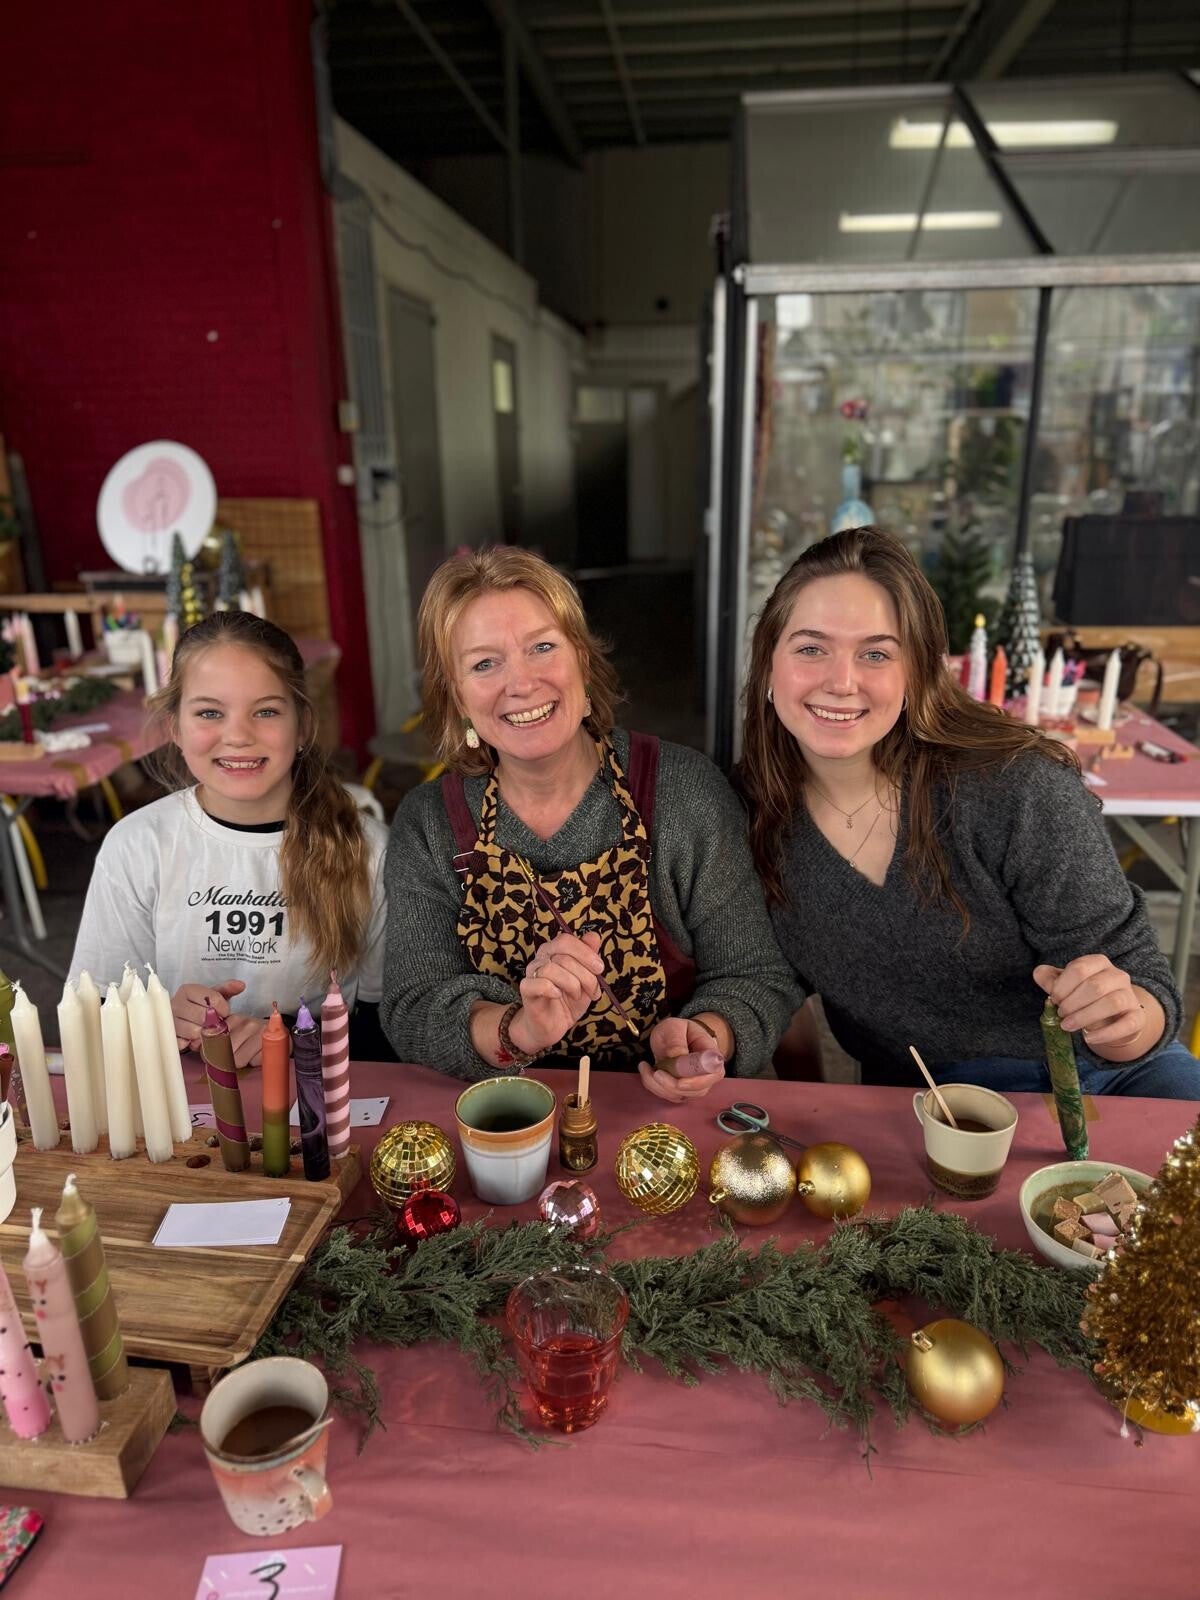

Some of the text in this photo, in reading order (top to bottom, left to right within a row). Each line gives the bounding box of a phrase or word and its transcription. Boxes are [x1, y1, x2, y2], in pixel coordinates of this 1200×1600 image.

[205, 910, 284, 936] 1991
[207, 936, 277, 954] New York
[249, 1562, 287, 1600] 3
